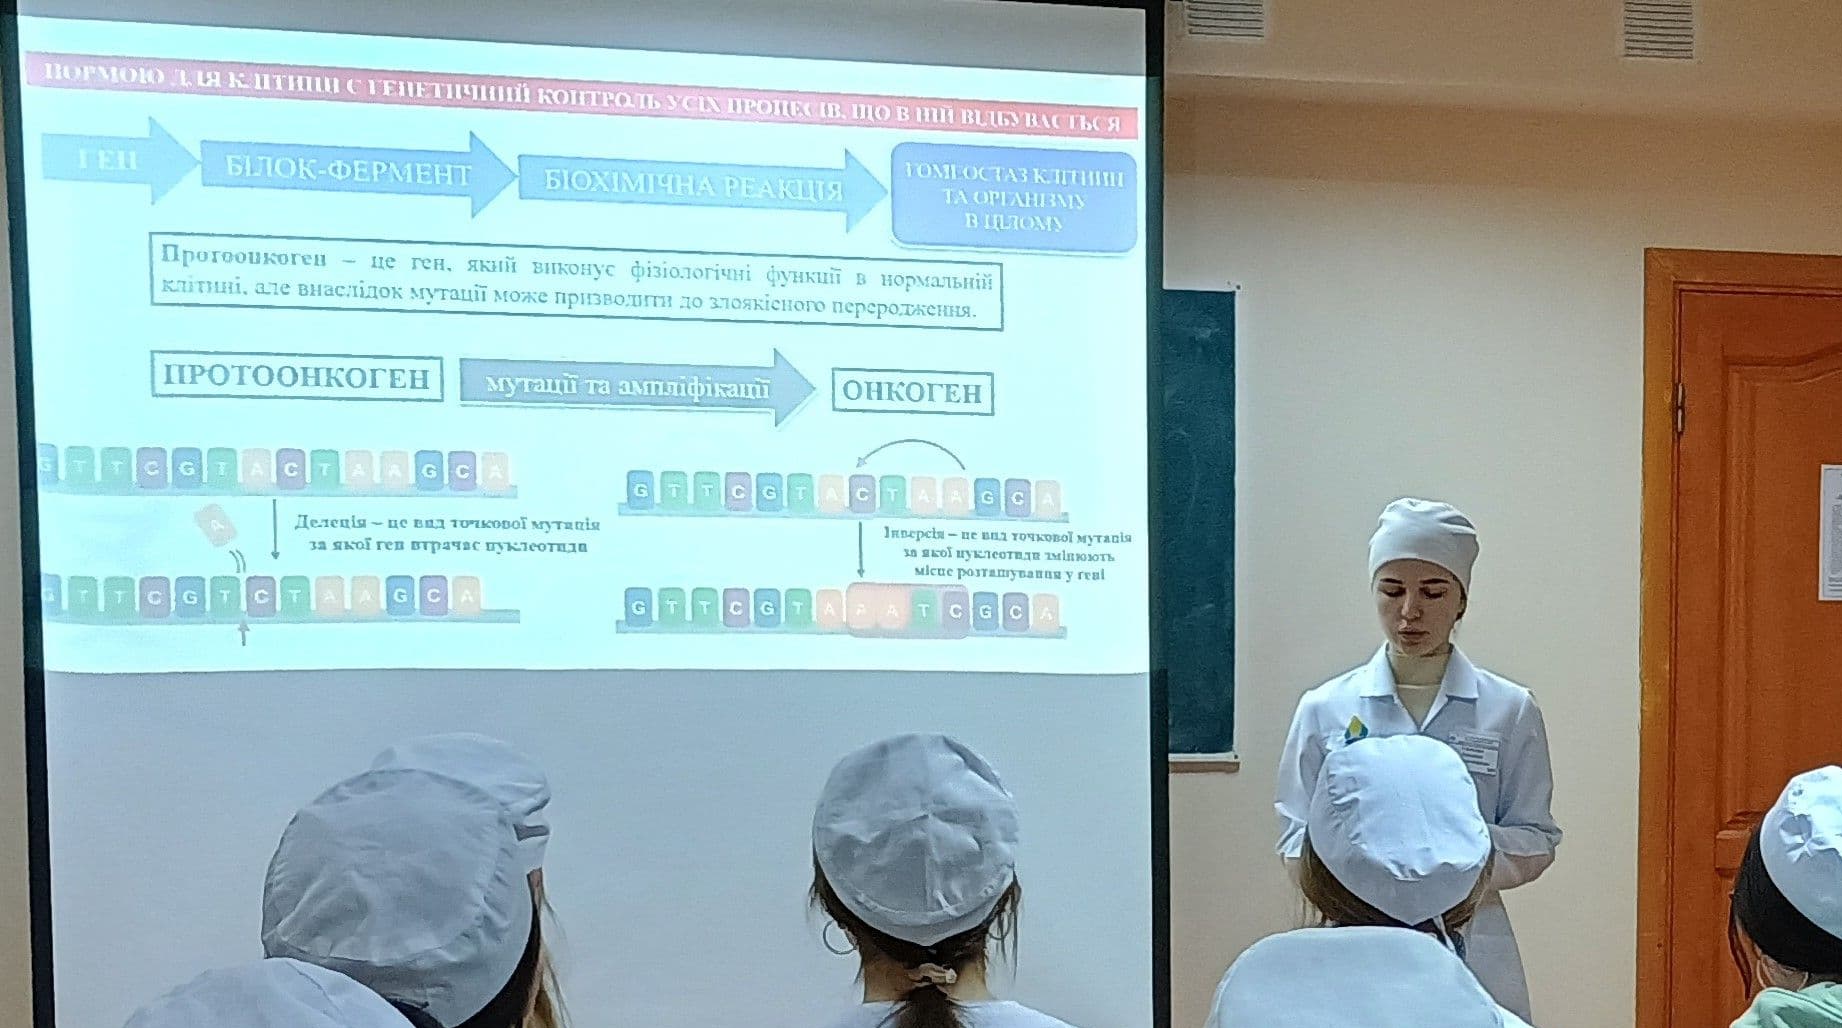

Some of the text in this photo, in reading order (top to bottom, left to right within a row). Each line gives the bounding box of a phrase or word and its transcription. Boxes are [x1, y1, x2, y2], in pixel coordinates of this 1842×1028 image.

[538, 87, 661, 111] КОНТРОЛЬ
[667, 95, 721, 113] УСІХ
[852, 103, 891, 123] ЩО
[896, 105, 910, 122] В
[79, 149, 137, 171] ГЕН
[225, 153, 472, 186] БІЛОК-ФЕРМЕНТ
[545, 168, 844, 203] БІОХІМІЧНА РЕАКЦІЯ
[943, 188, 1086, 210] ТА ОРГАНІЗМУ
[965, 212, 1064, 233] В ЦІЛОМУ
[161, 243, 327, 267] Протоонкоген
[371, 255, 396, 271] це
[467, 256, 518, 273] який
[532, 261, 616, 281] виконує
[631, 260, 752, 283] фізіологічні
[766, 265, 841, 287] функції
[856, 273, 867, 285] в
[881, 273, 993, 292] нормальній
[255, 281, 291, 296] але
[298, 279, 403, 299] внаслідок
[411, 284, 488, 305] мутації
[494, 290, 549, 304] може
[555, 290, 673, 310] призводити
[679, 295, 704, 311] до
[832, 302, 978, 320] переродження.
[163, 362, 431, 391] ПРОТООНКОГЕН
[486, 372, 771, 403] мутації та ампліфікації
[842, 378, 983, 405] ОНКОГЕН
[295, 515, 367, 530] Делеція
[388, 519, 408, 531] це
[414, 519, 446, 530] вид
[450, 516, 528, 531] точкової
[884, 526, 945, 543] Інверсія
[1011, 530, 1073, 543] точкової
[308, 541, 327, 551] за
[332, 538, 371, 551] якої
[376, 541, 405, 552] ген
[922, 546, 953, 558] якої
[957, 568, 1062, 581] розташування
[1065, 570, 1074, 582] у
[1077, 569, 1106, 581] гені
